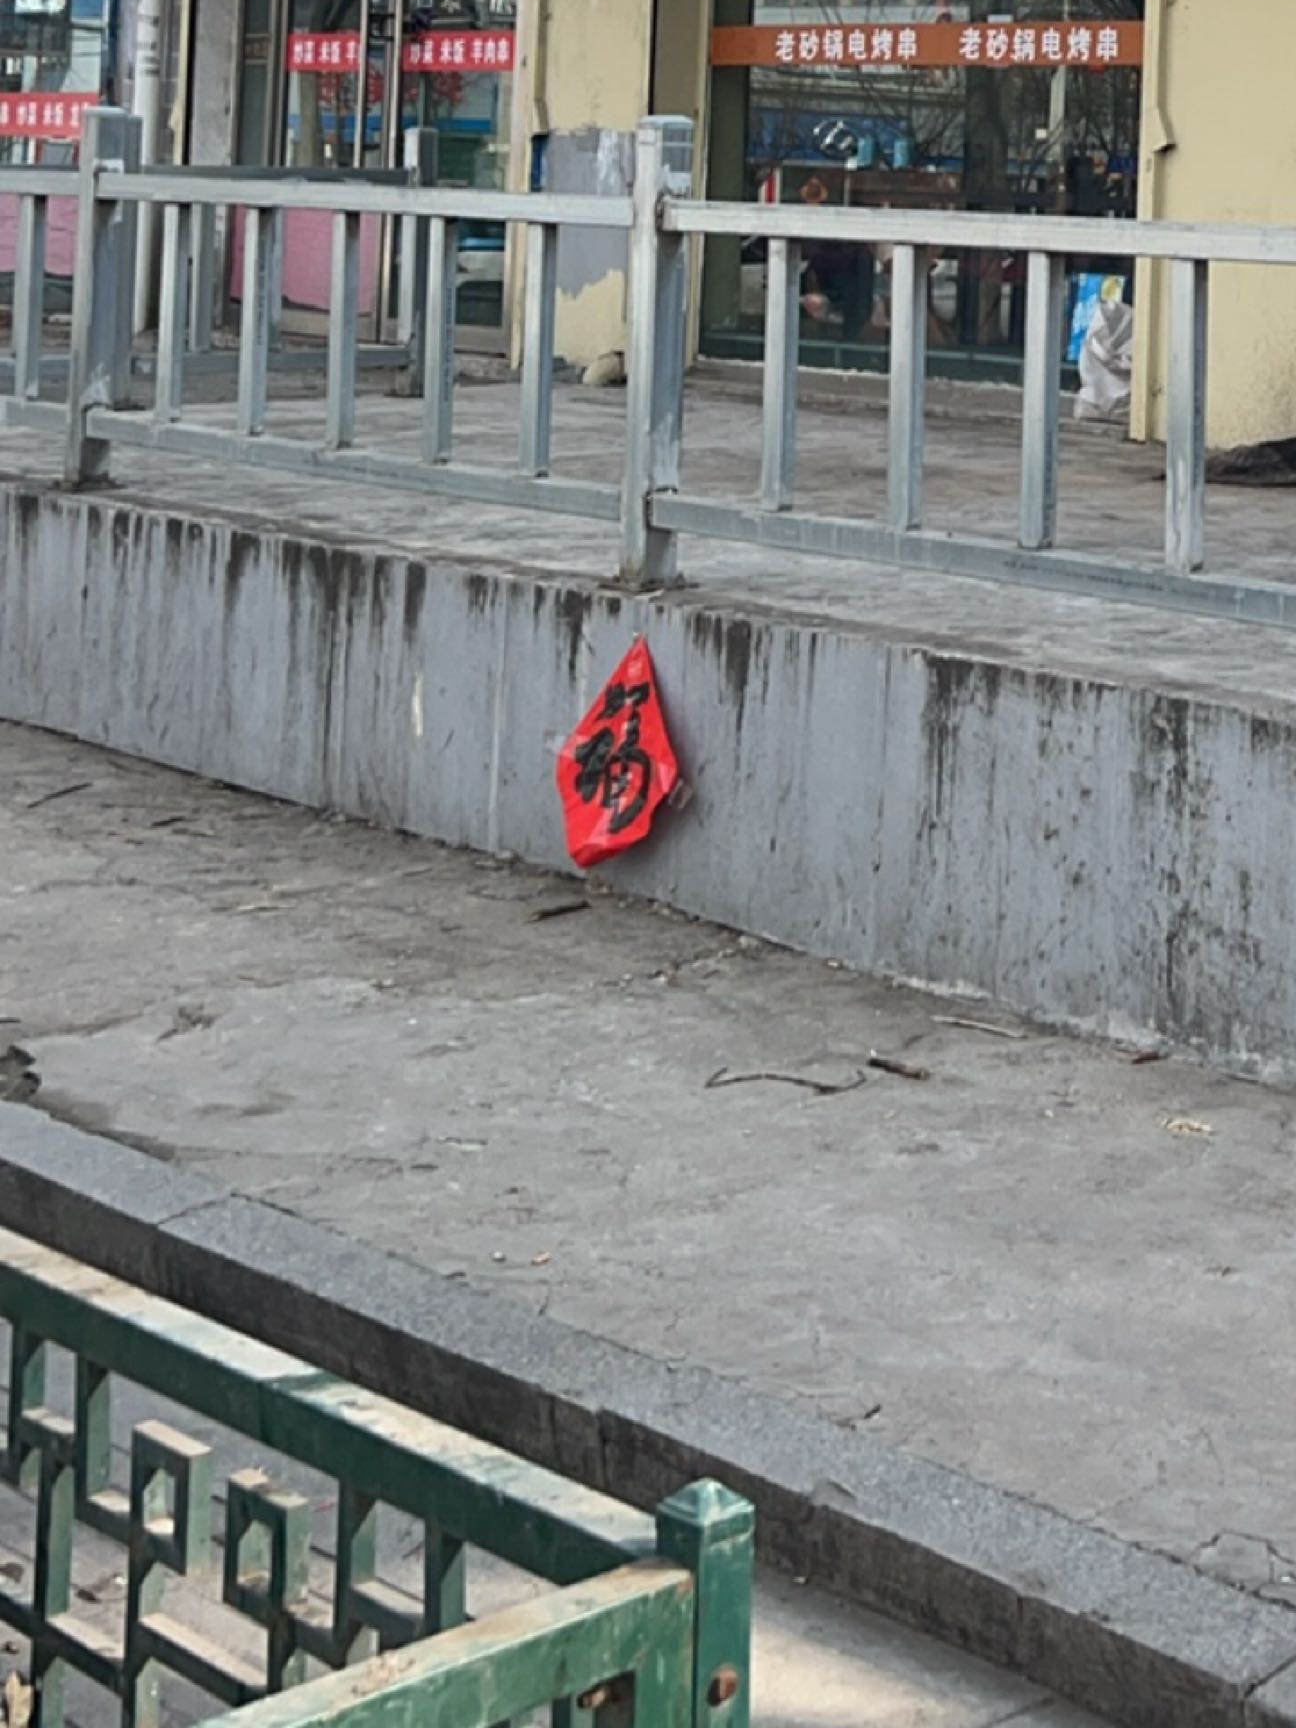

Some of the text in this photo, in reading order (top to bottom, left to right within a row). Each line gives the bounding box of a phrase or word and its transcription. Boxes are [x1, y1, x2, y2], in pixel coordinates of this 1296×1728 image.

[776, 26, 1119, 62] 老砂锅电烤串 老砂锅电烤串
[575, 681, 652, 834] 福
